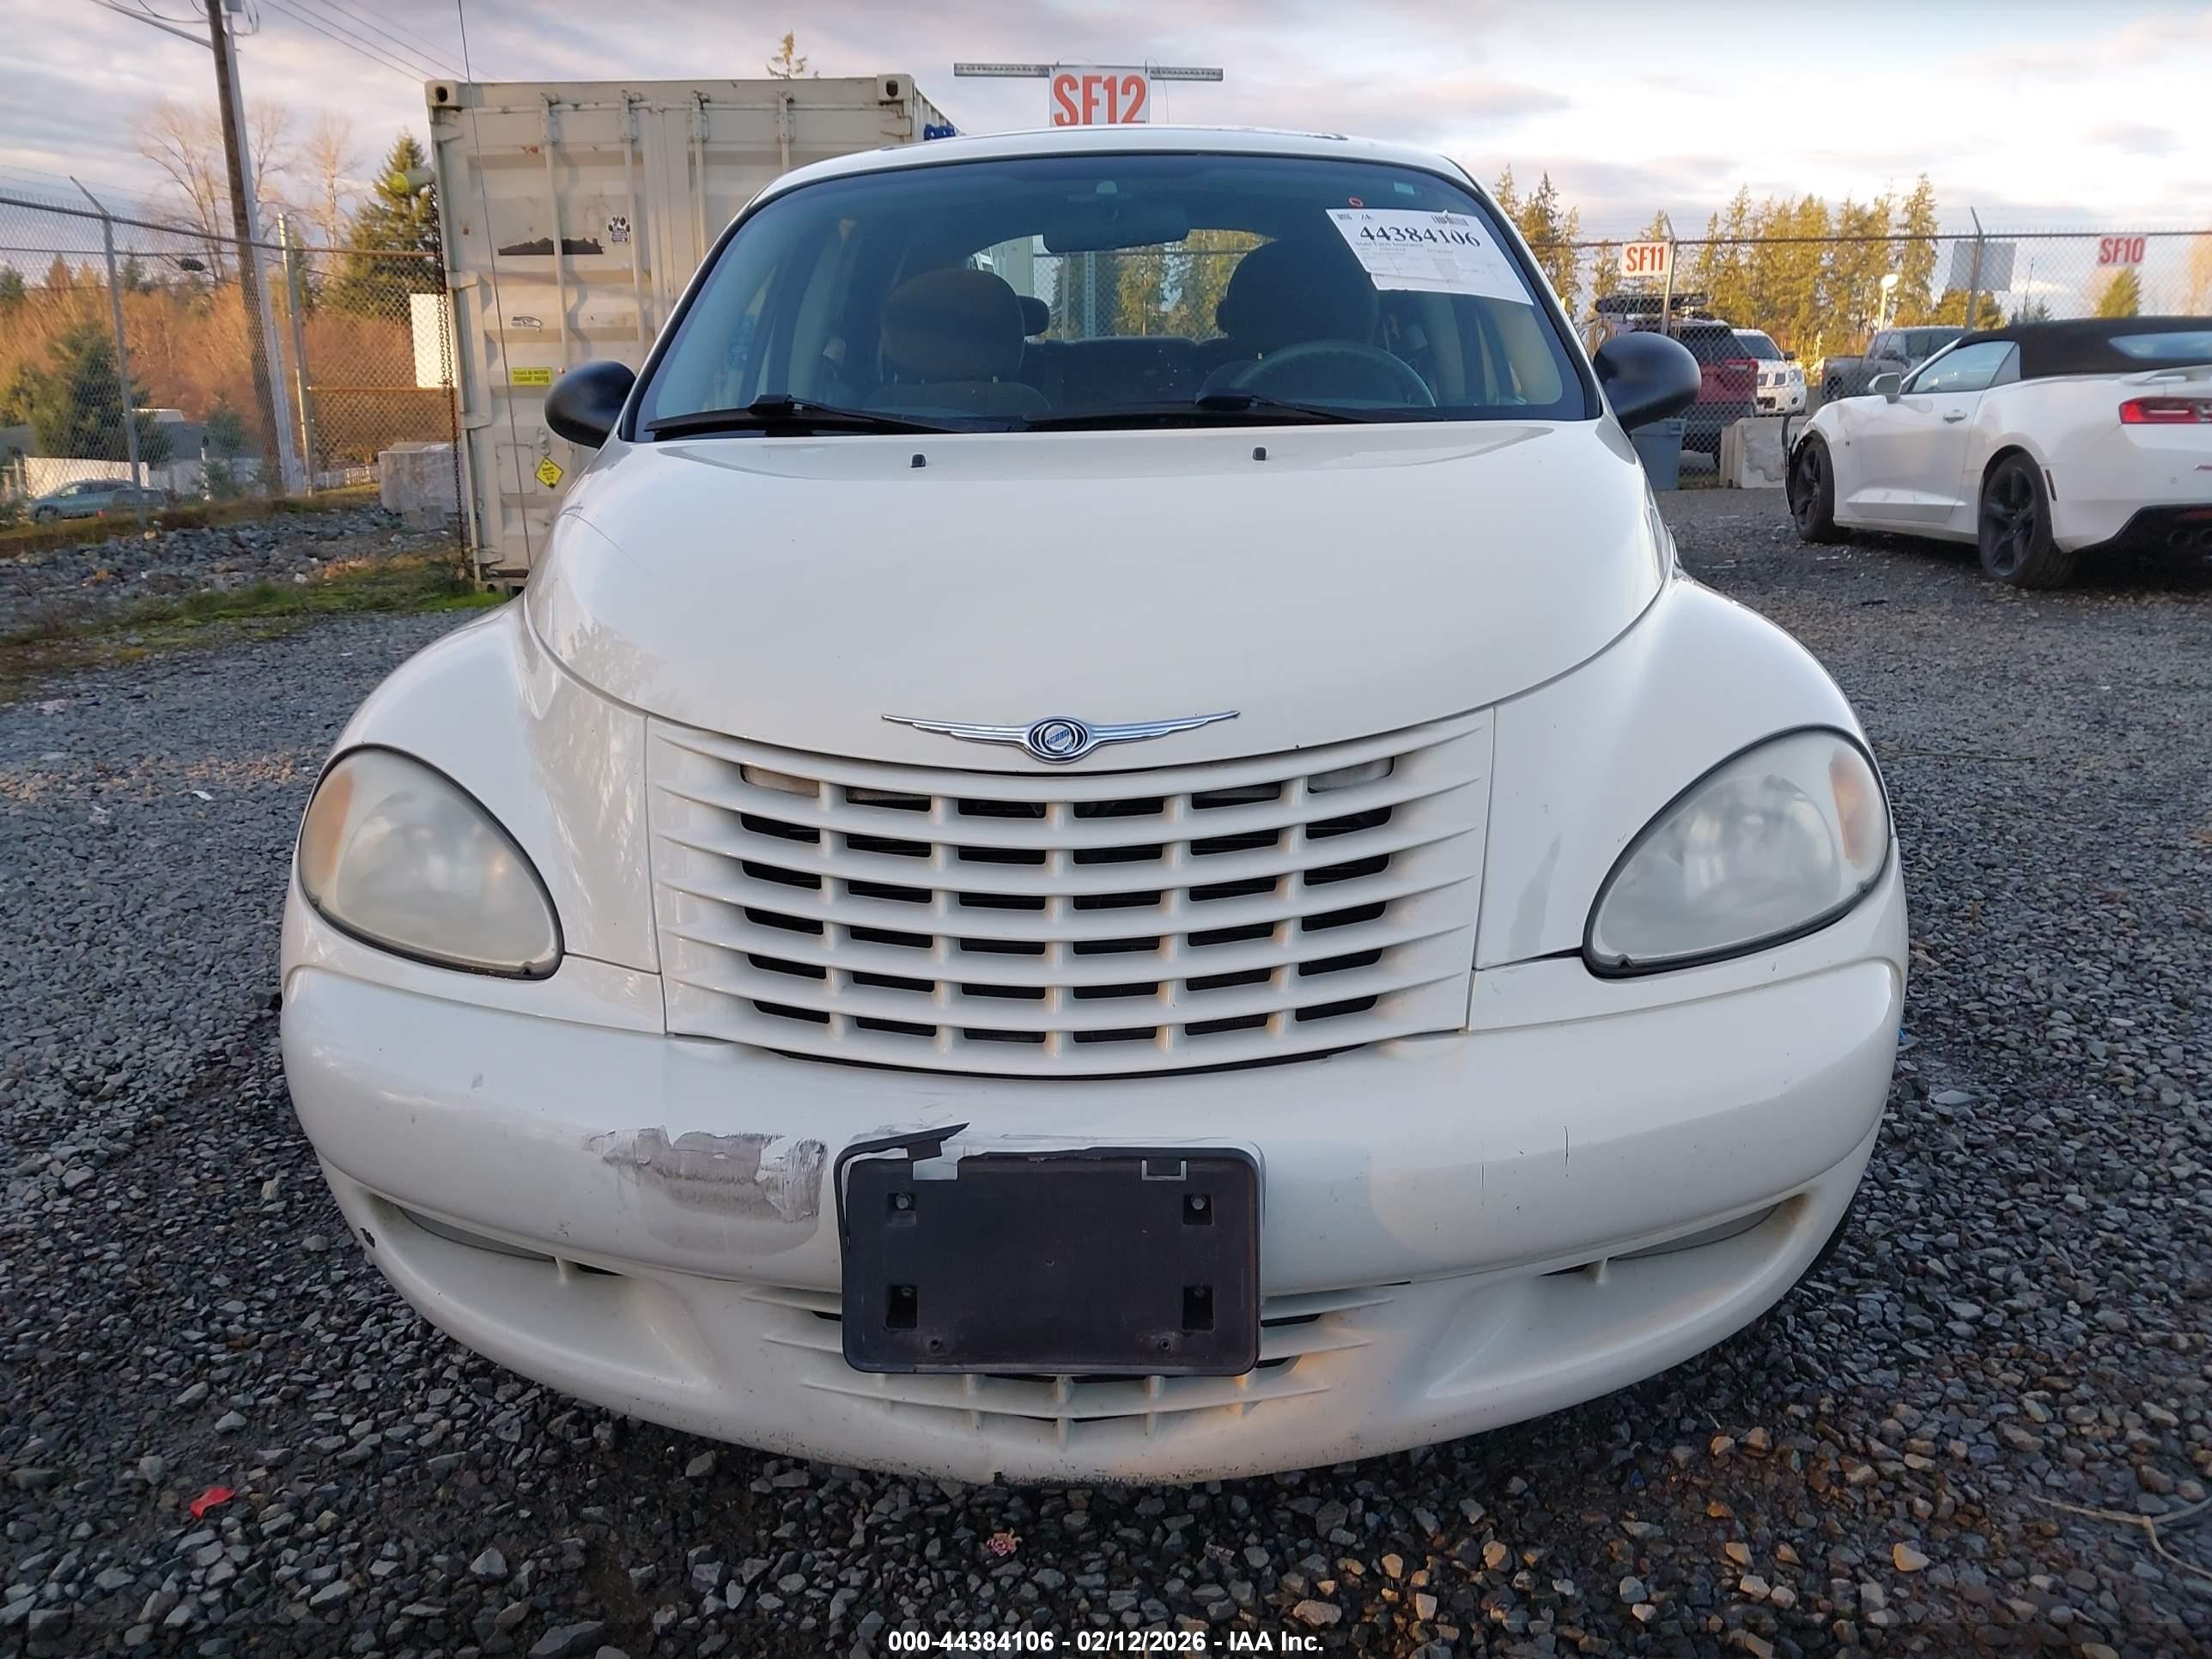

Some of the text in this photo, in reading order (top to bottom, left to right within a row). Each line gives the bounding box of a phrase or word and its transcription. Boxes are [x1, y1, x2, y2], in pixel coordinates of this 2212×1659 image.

[1054, 74, 1146, 126] SF12
[1359, 226, 1481, 247] 44384106
[1626, 246, 1664, 272] SF11
[2100, 237, 2144, 264] SF10
